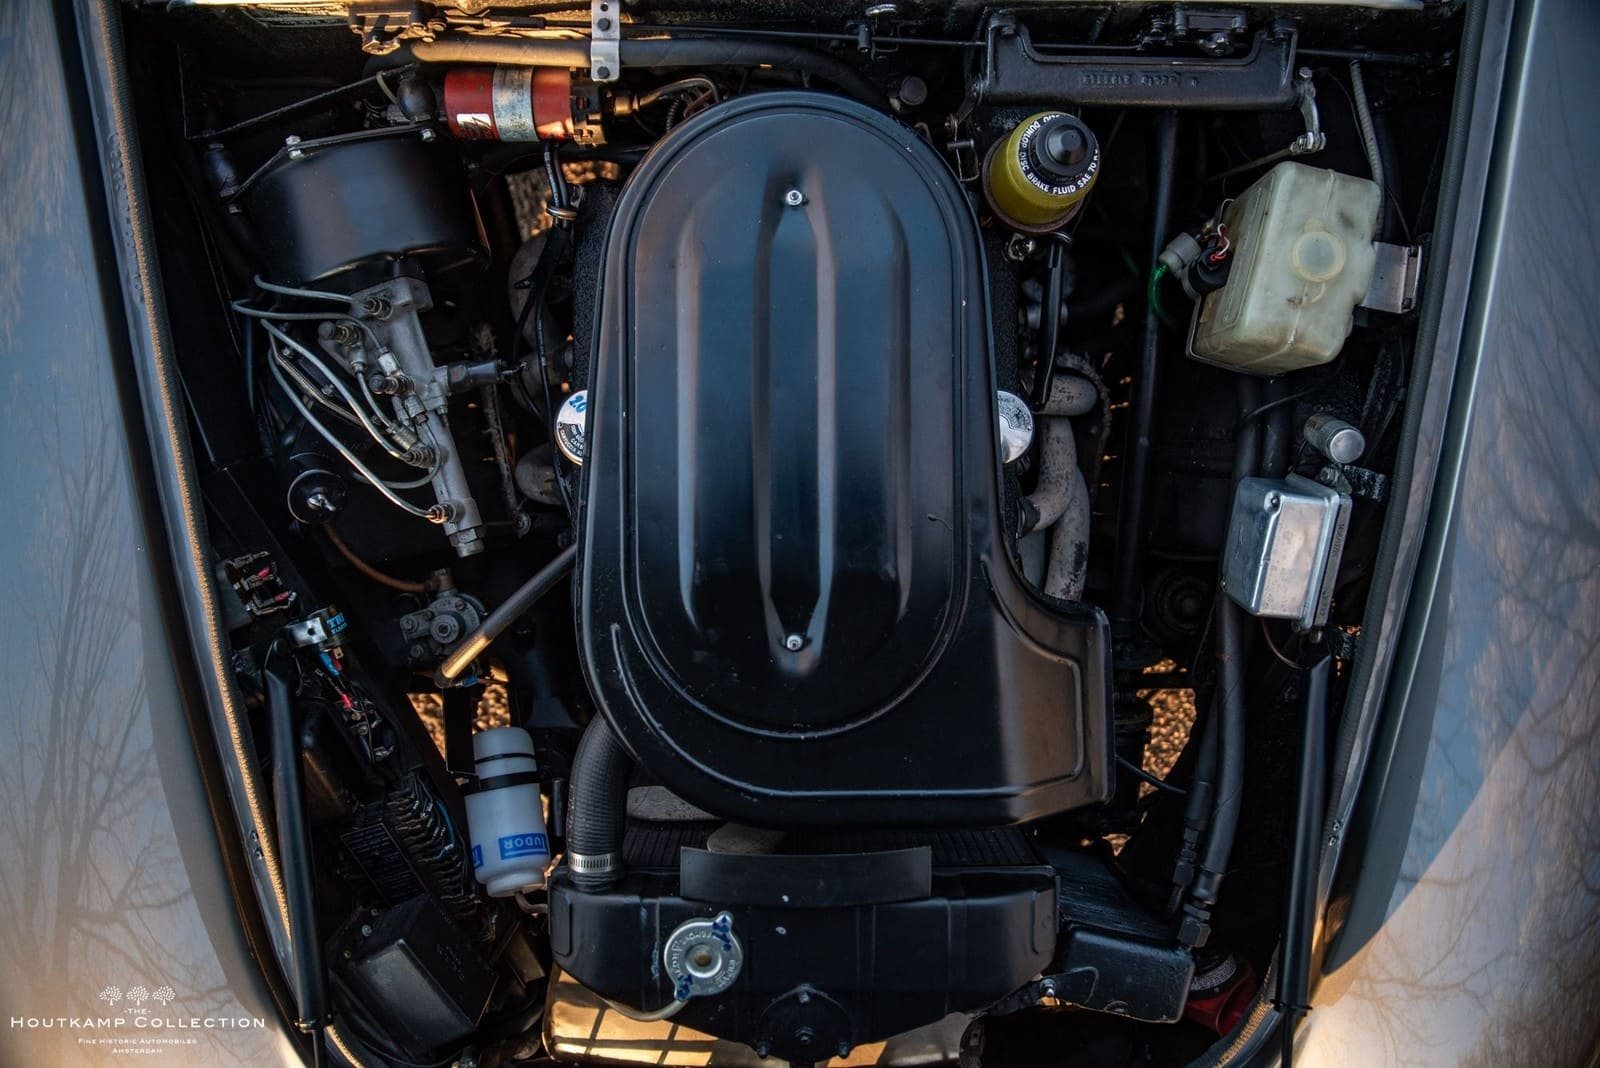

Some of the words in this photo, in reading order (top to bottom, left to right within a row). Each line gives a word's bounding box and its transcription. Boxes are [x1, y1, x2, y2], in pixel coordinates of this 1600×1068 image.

[1020, 121, 1041, 149] DUNLOP
[1019, 152, 1030, 171] DISC
[1088, 162, 1097, 172] 70
[1027, 173, 1050, 192] BRAKE
[1078, 174, 1092, 188] SAE
[1053, 184, 1076, 195] FLUID
[504, 836, 545, 849] TUDOR
